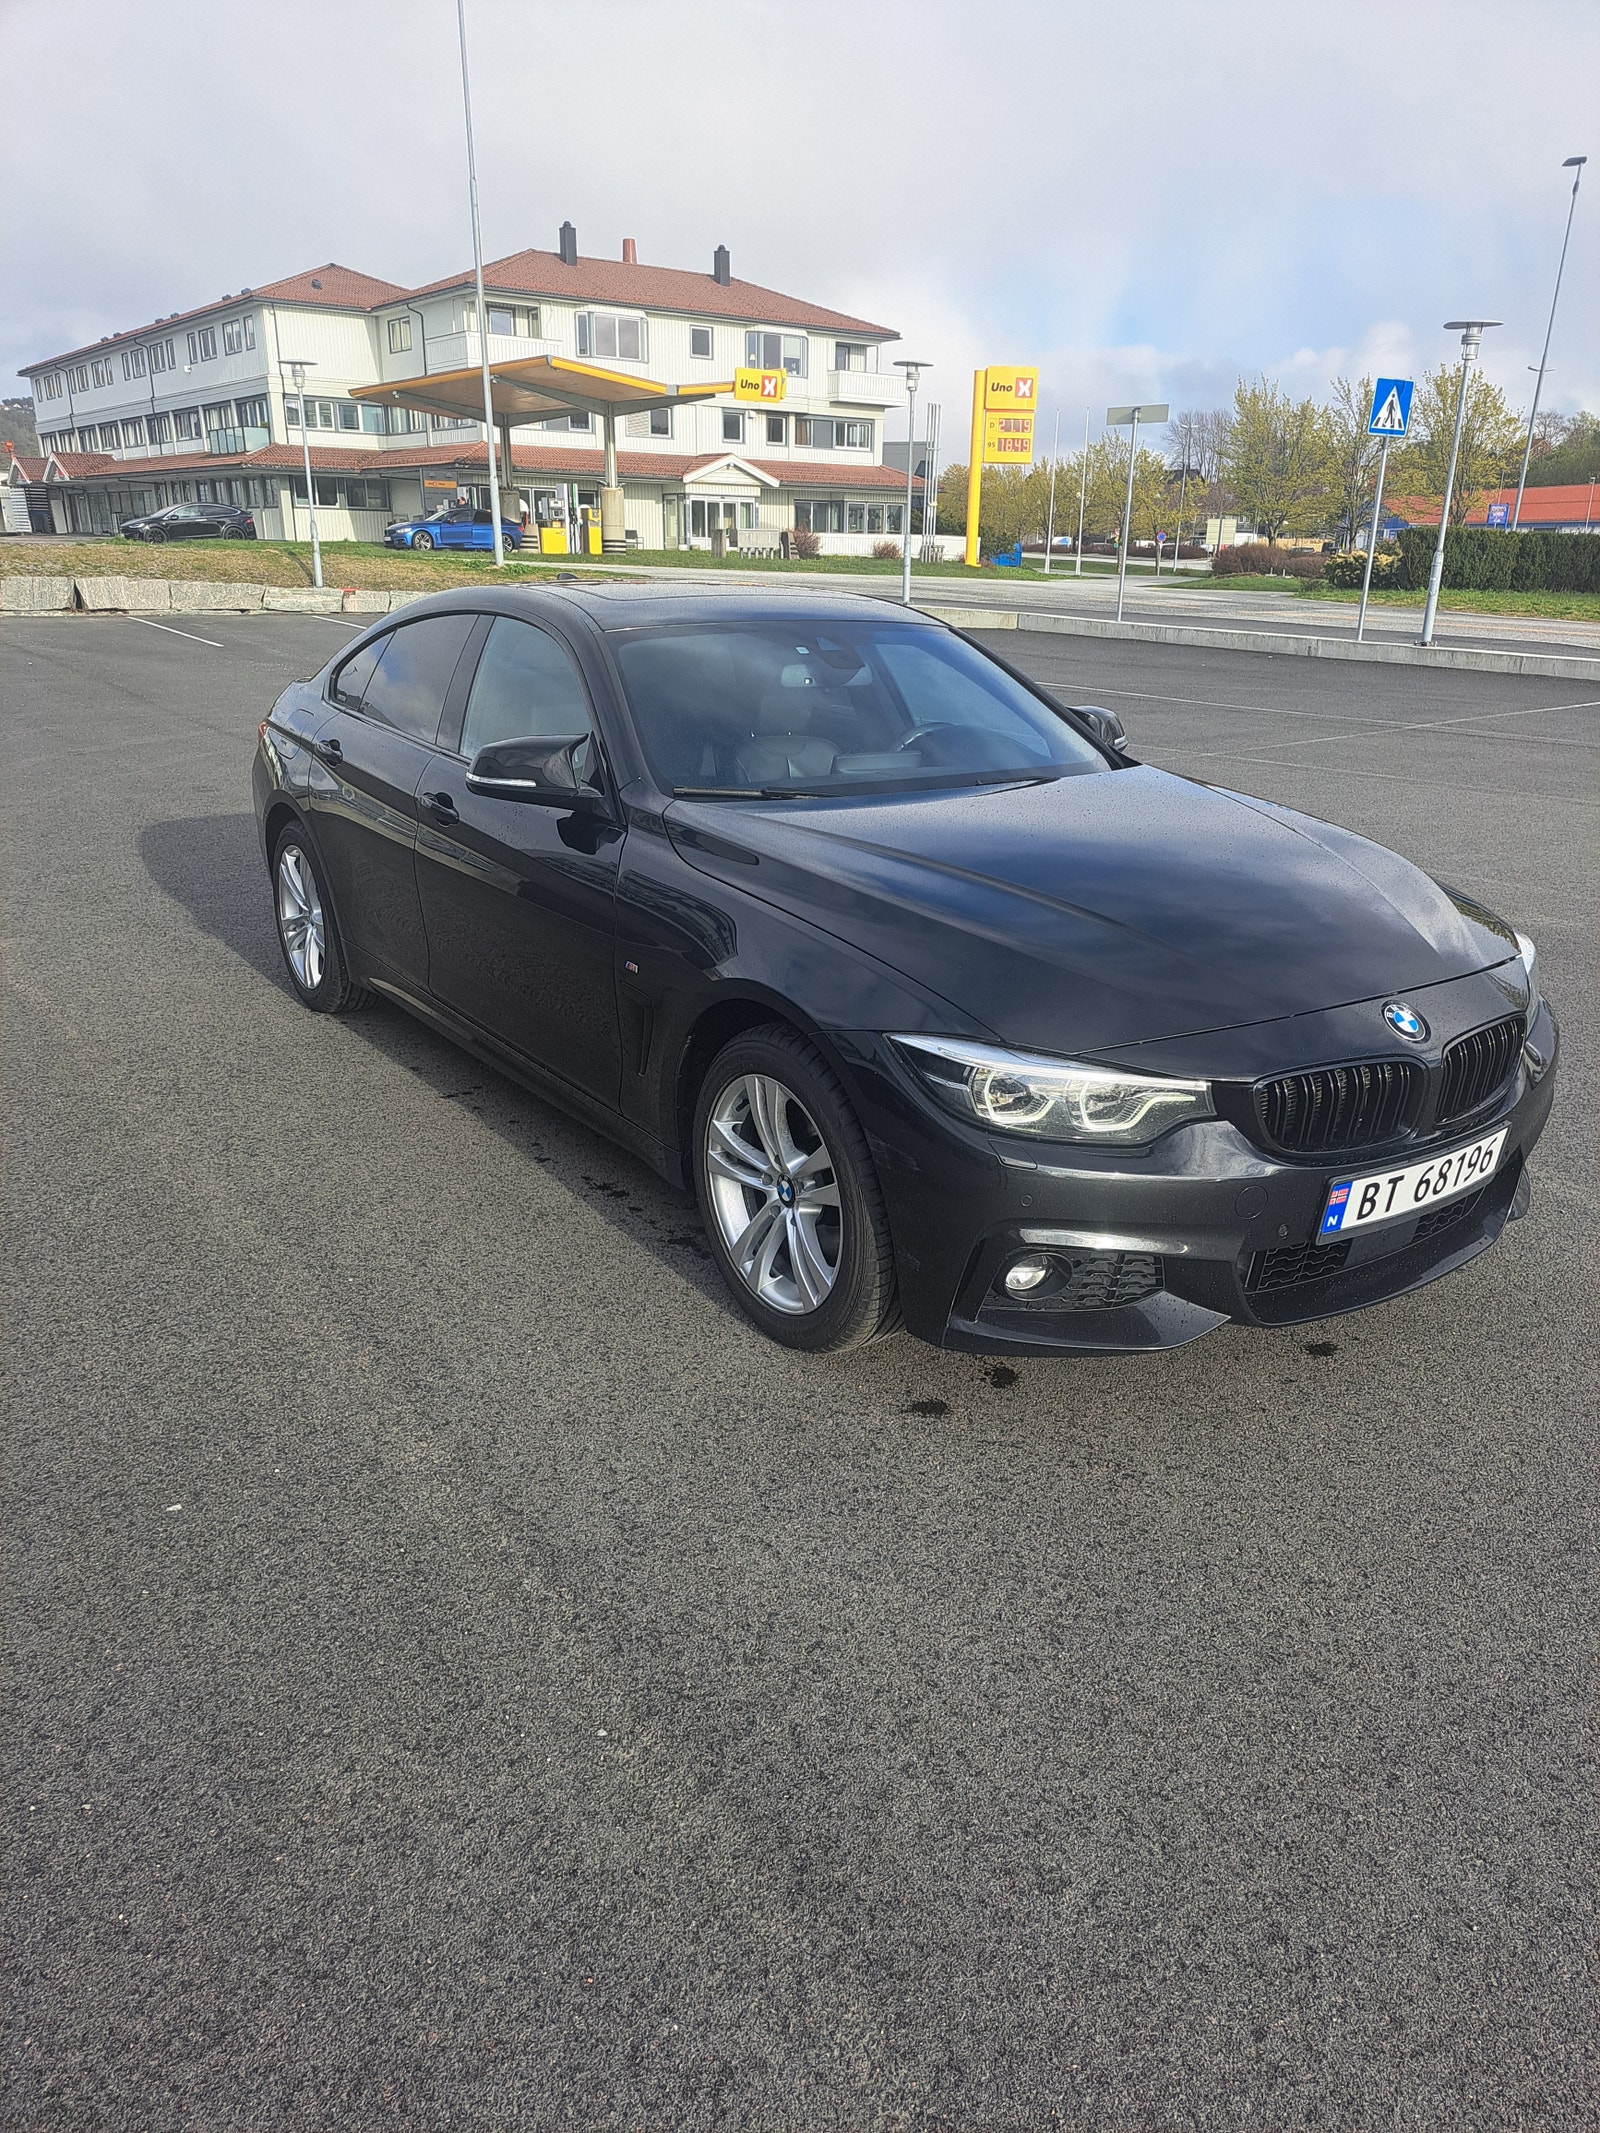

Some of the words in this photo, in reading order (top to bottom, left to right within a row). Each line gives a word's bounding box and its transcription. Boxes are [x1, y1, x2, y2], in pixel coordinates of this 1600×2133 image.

[741, 379, 760, 390] Uno
[763, 377, 777, 396] X
[991, 382, 1013, 392] Uno
[1017, 379, 1032, 397] X
[1000, 438, 1030, 452] 18.49
[1356, 1175, 1405, 1220] BT
[1413, 1136, 1499, 1203] 68196
[1327, 1214, 1338, 1227] N
